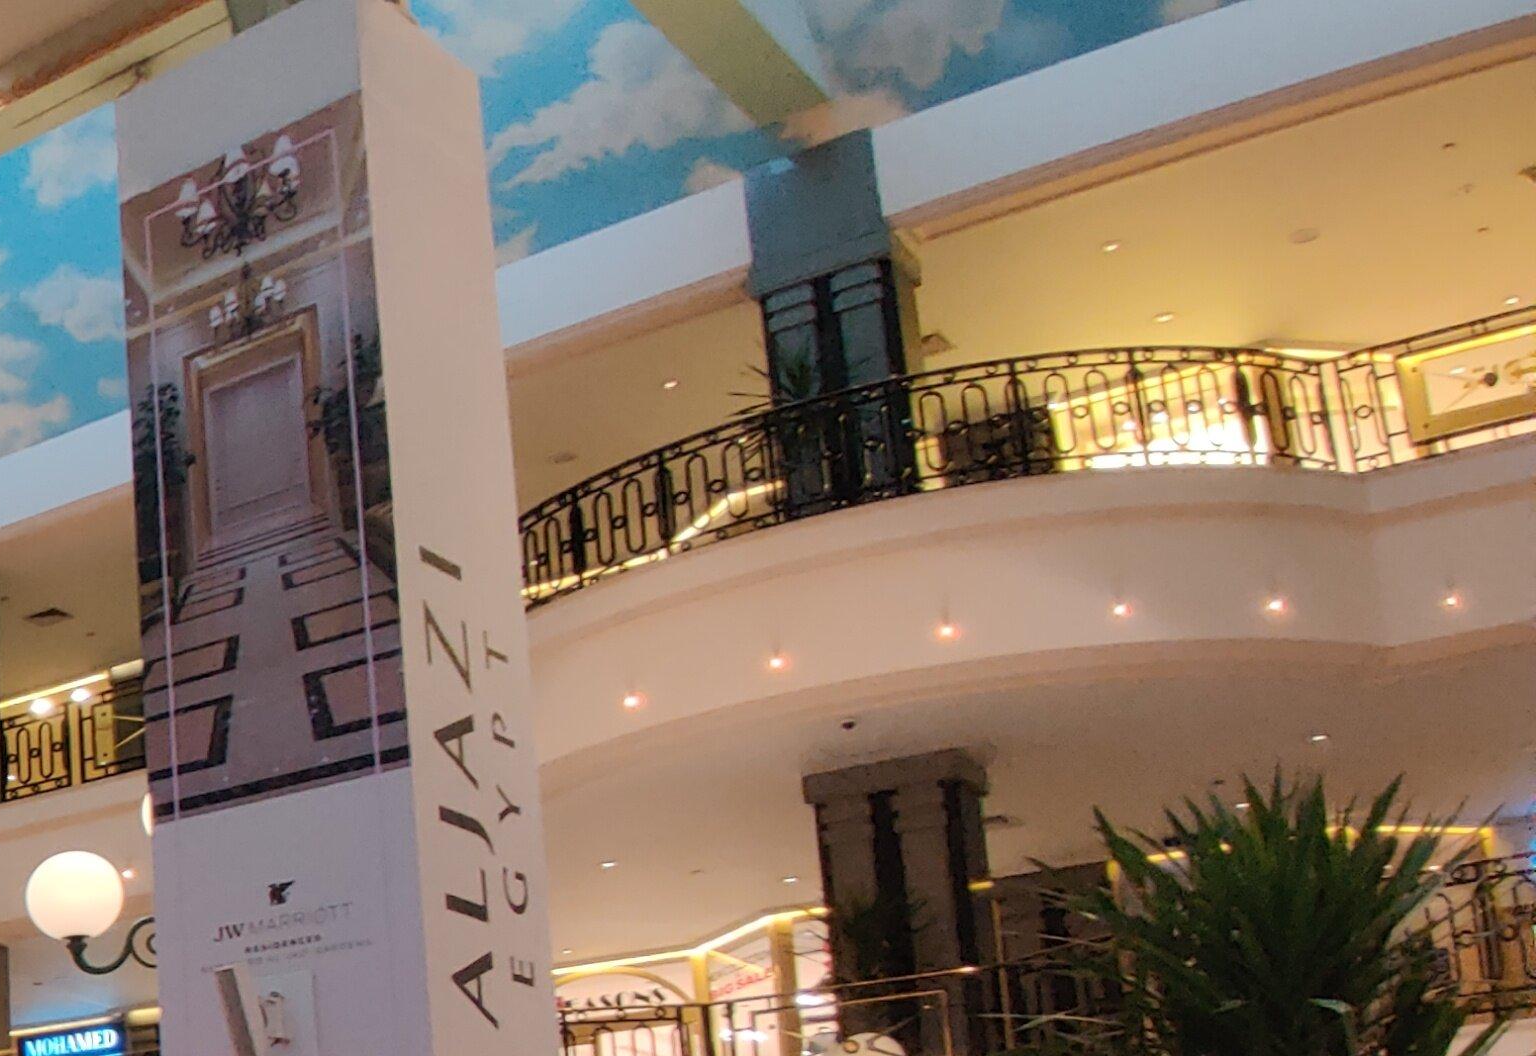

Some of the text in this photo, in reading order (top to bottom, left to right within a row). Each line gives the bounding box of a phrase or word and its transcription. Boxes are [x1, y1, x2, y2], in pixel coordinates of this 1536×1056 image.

[213, 922, 245, 943] JW
[419, 544, 499, 1030] ALJAZI
[481, 630, 535, 988] EGYPT
